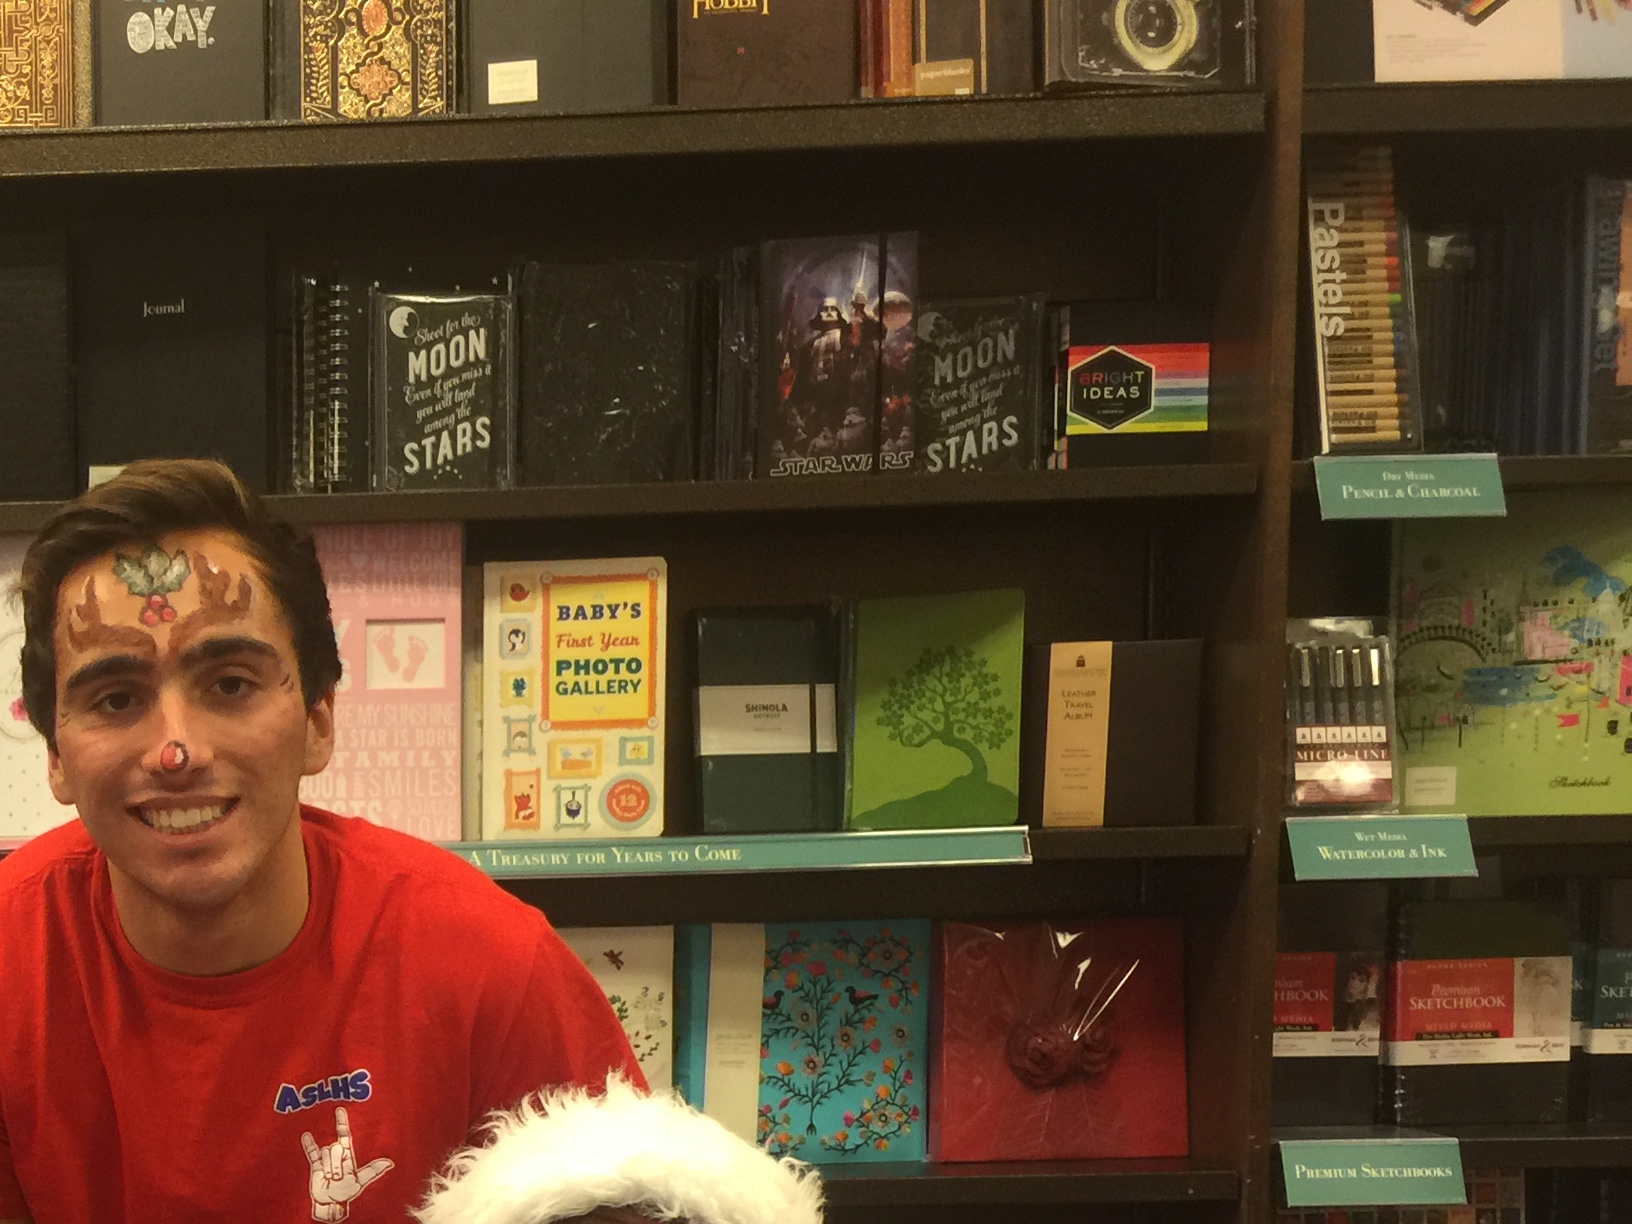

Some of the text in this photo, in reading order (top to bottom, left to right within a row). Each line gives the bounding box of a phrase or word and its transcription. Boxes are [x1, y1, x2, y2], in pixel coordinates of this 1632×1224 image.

[1310, 201, 1351, 337] Pastels
[445, 319, 459, 339] for
[408, 327, 487, 384] MOON
[933, 328, 1015, 386] MOON
[1079, 371, 1145, 385] BRIGHT
[1082, 386, 1140, 399] IDEAS
[404, 416, 491, 475] STARS
[927, 415, 1018, 473] STARS
[770, 456, 842, 477] STAR
[556, 603, 642, 622] BABY'S
[556, 632, 640, 651] First Year
[556, 658, 642, 677] PHOTO
[555, 679, 642, 696] GALLERY
[384, 703, 456, 726] SUNSHINE
[745, 703, 788, 713] SHINOLA
[349, 729, 387, 746] STAR
[416, 728, 457, 746] BORN
[334, 751, 456, 768] FAMILY
[369, 769, 456, 797] SMILES
[487, 849, 570, 866] TREASURY
[577, 852, 605, 864] FOR
[611, 847, 663, 863] YEARS
[670, 850, 689, 862] TO
[694, 845, 741, 861] COME
[1318, 844, 1447, 860] WATERCOLOR & INK
[1409, 995, 1506, 1011] SKETCHBOOK
[1295, 1163, 1452, 1179] PREMIUM SKETCHBOOKS
